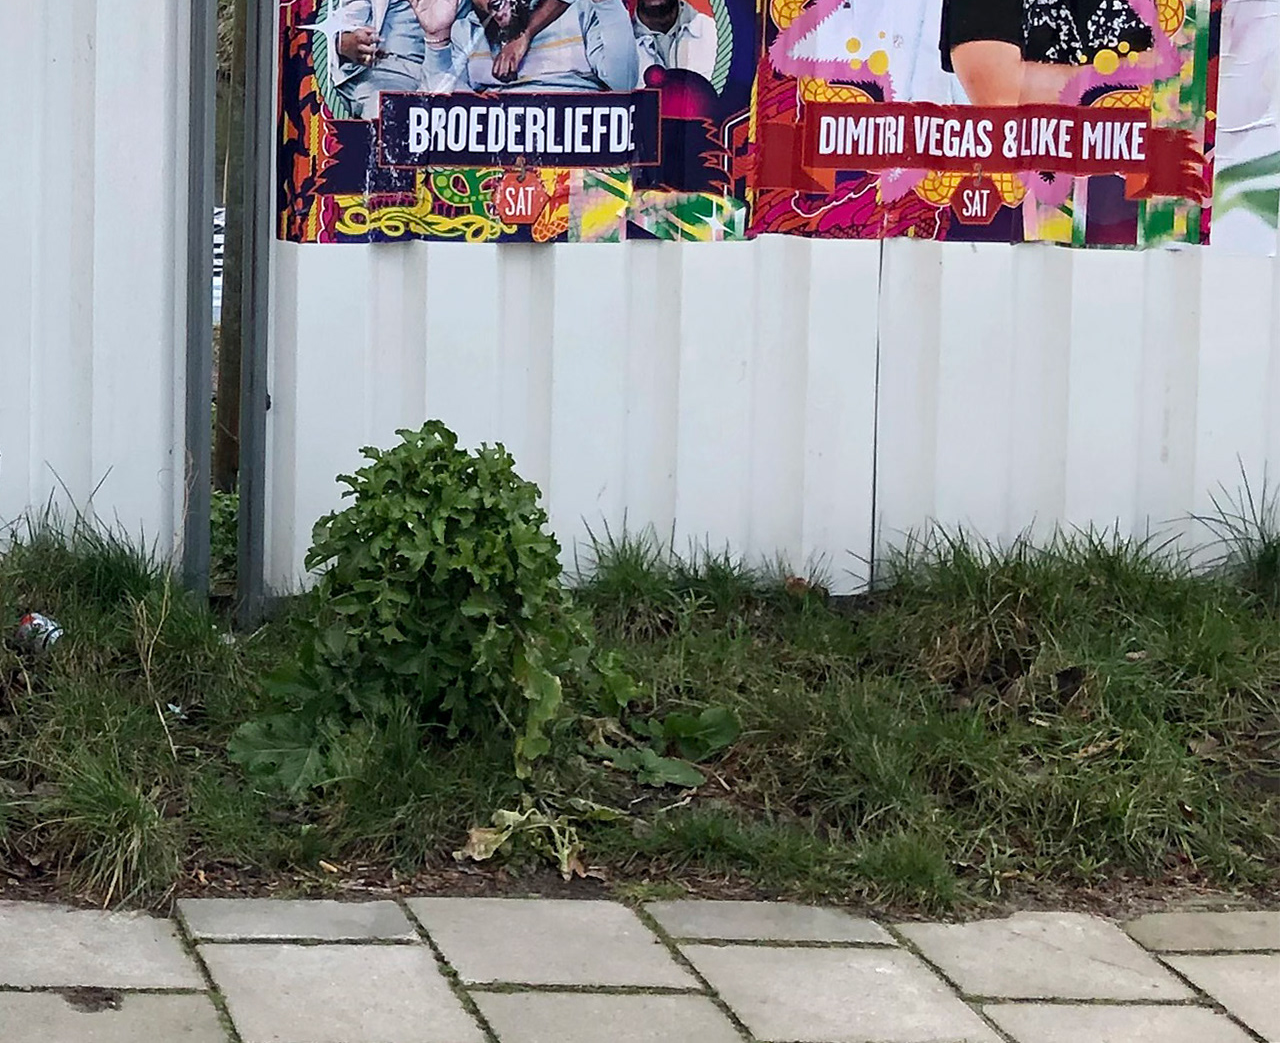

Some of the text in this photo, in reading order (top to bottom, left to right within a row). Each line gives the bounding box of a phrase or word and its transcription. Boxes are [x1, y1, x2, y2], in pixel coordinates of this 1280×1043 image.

[819, 115, 904, 155] DIMITRI
[913, 116, 993, 158] VEGAS
[1081, 121, 1147, 160] MIKE
[505, 186, 534, 216] SAT
[962, 189, 990, 217] SAT
